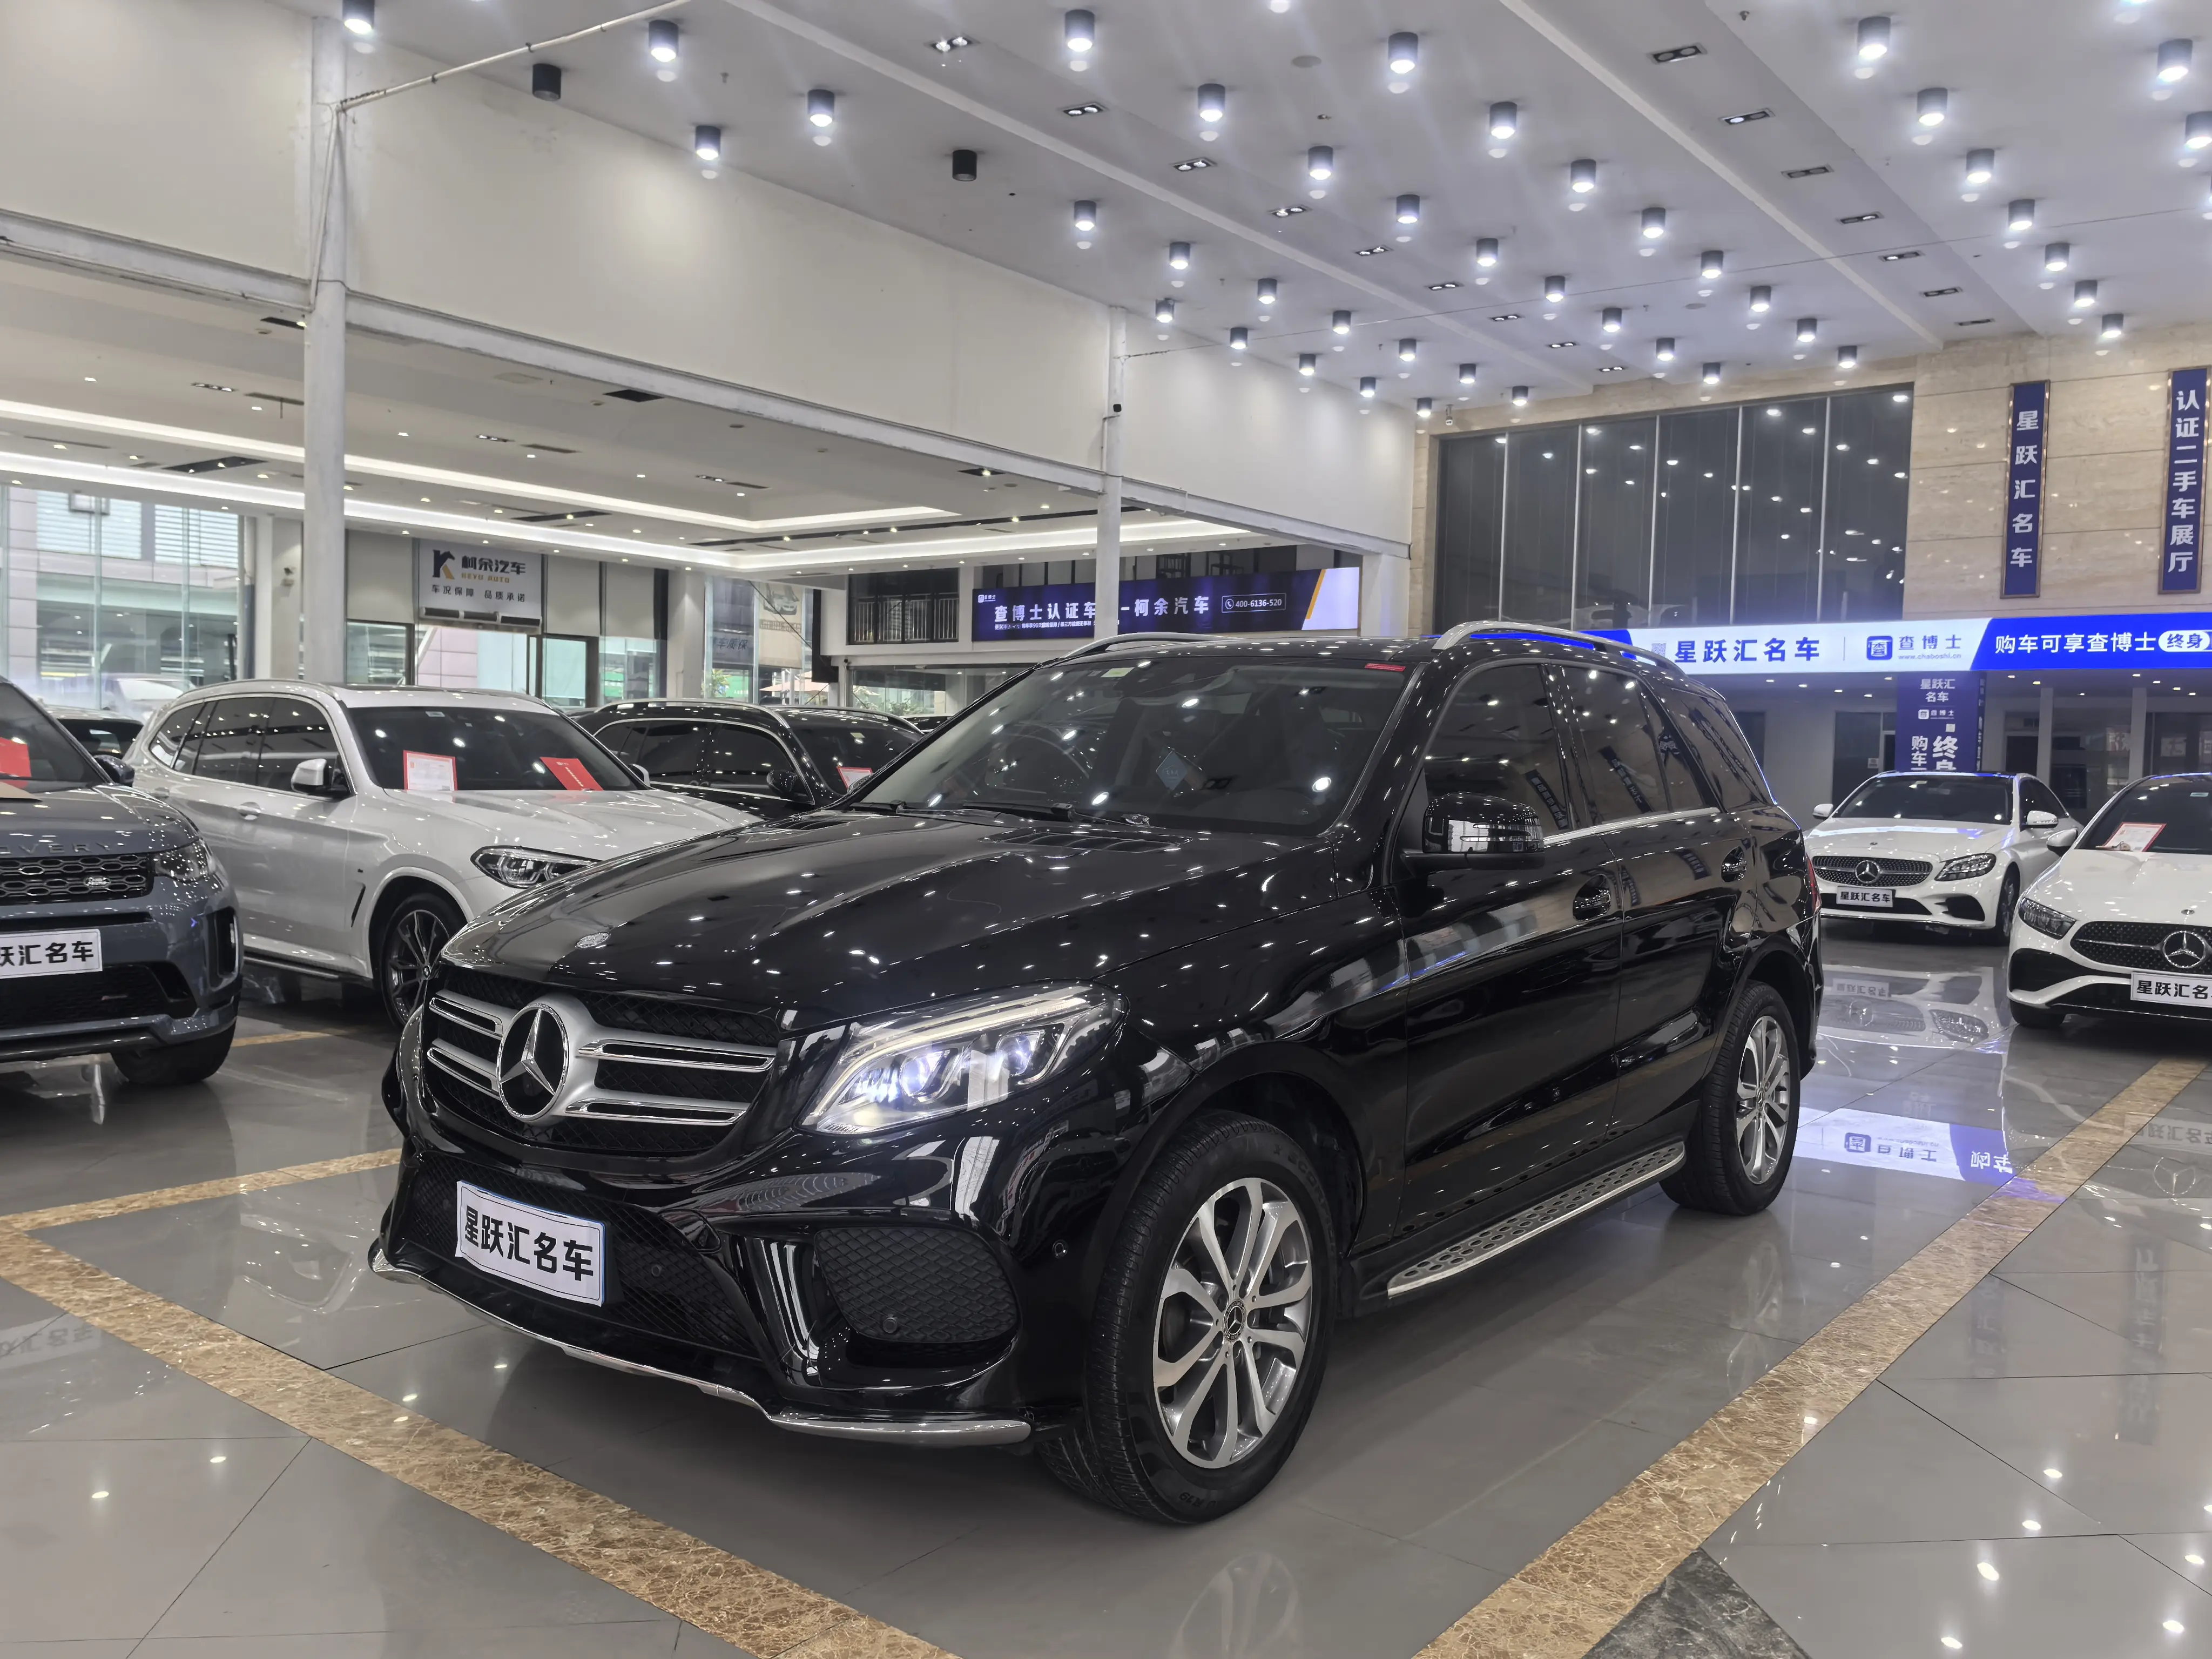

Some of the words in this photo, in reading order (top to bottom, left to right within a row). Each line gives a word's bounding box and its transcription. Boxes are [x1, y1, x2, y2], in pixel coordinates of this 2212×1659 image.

[2010, 410, 2039, 568] 星跃汇名车
[2168, 390, 2200, 572] 认证二手车展厅
[461, 555, 526, 575] 柯余汽车
[431, 584, 474, 597] 车况保障
[484, 590, 525, 602] 品质承诺
[1235, 599, 1282, 608] 400-6136-520
[1674, 637, 1819, 663] 星跃汇名车
[1899, 635, 1961, 650] 查博士
[1995, 631, 2156, 654] 购车可享查博士
[2167, 633, 2203, 649] 终身
[1920, 678, 1955, 690] 星跃汇
[1925, 691, 1949, 702] 名车
[1911, 736, 1928, 770] 购车
[1840, 891, 1891, 903] 星跃汇名车
[2136, 980, 2212, 1000] 星跃汇名
[465, 1205, 594, 1282] 星跃汇名车
